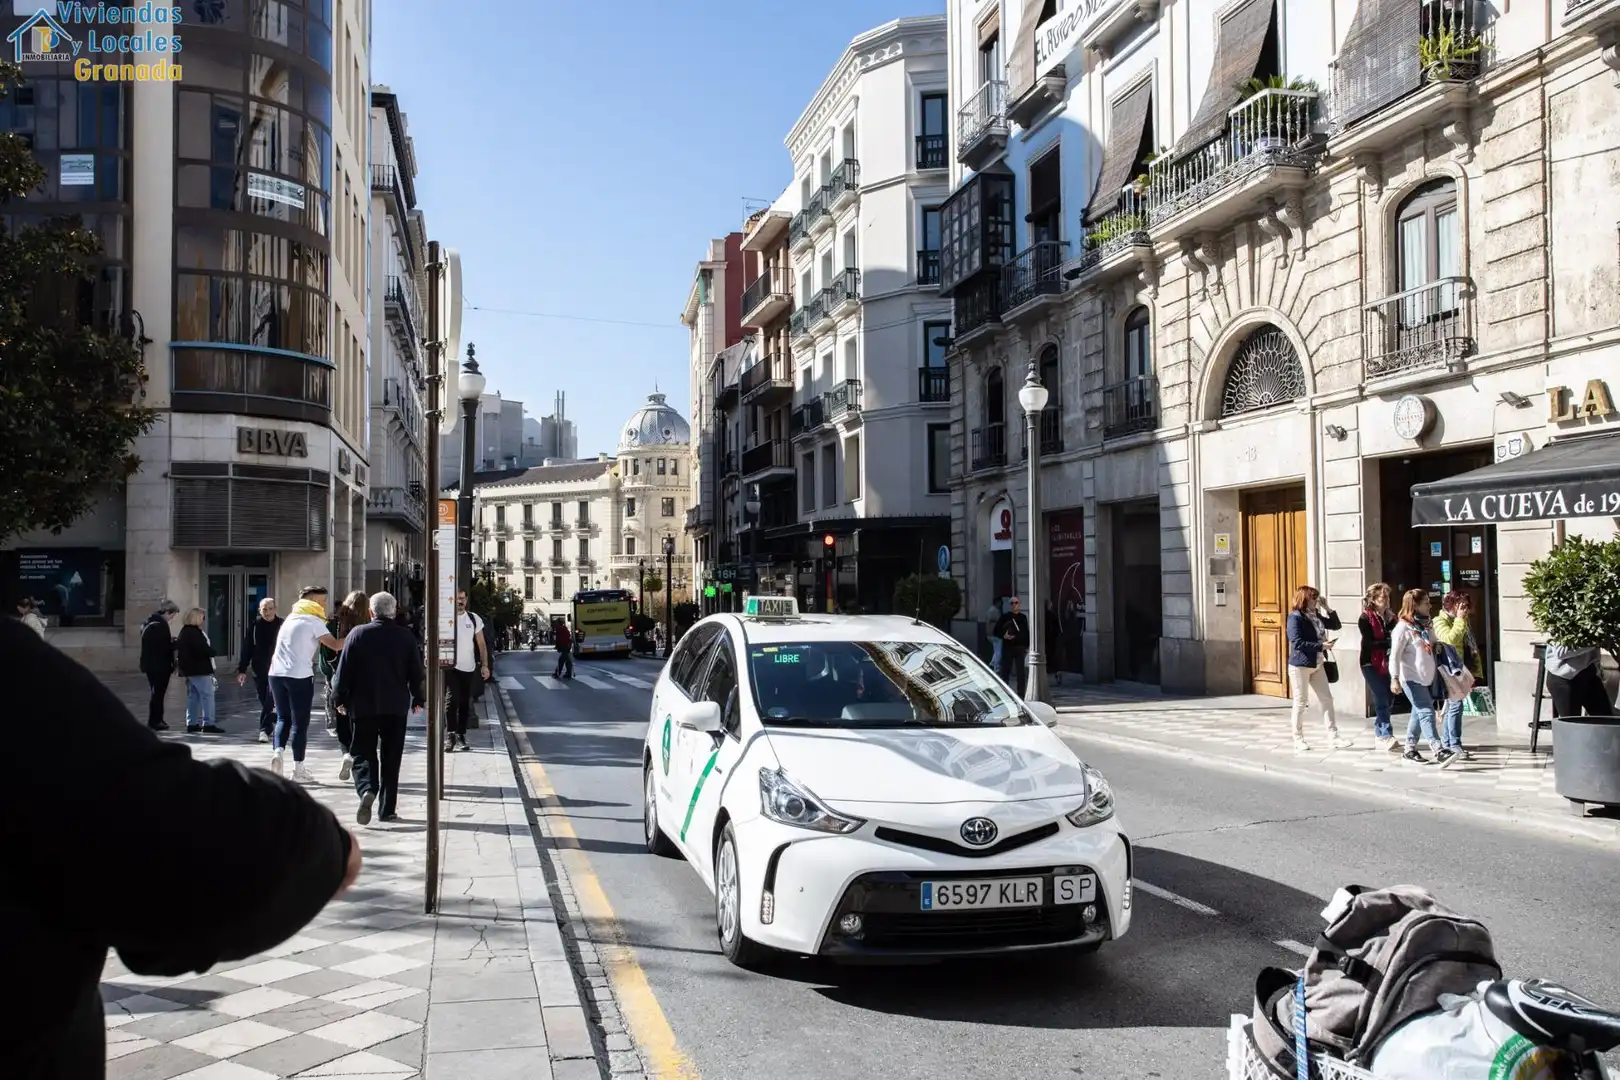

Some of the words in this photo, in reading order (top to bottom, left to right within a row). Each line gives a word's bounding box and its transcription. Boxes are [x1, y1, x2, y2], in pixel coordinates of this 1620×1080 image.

[1046, 4, 1084, 56] RUIDO
[1546, 378, 1614, 423] LA
[237, 426, 309, 458] BBVA
[1444, 498, 1476, 522] LA
[1480, 489, 1569, 520] CUEVA
[1573, 493, 1595, 514] de
[760, 600, 783, 613] TAXI
[774, 654, 800, 663] LIBRE
[937, 884, 992, 906] 6597
[999, 882, 1038, 904] KLR
